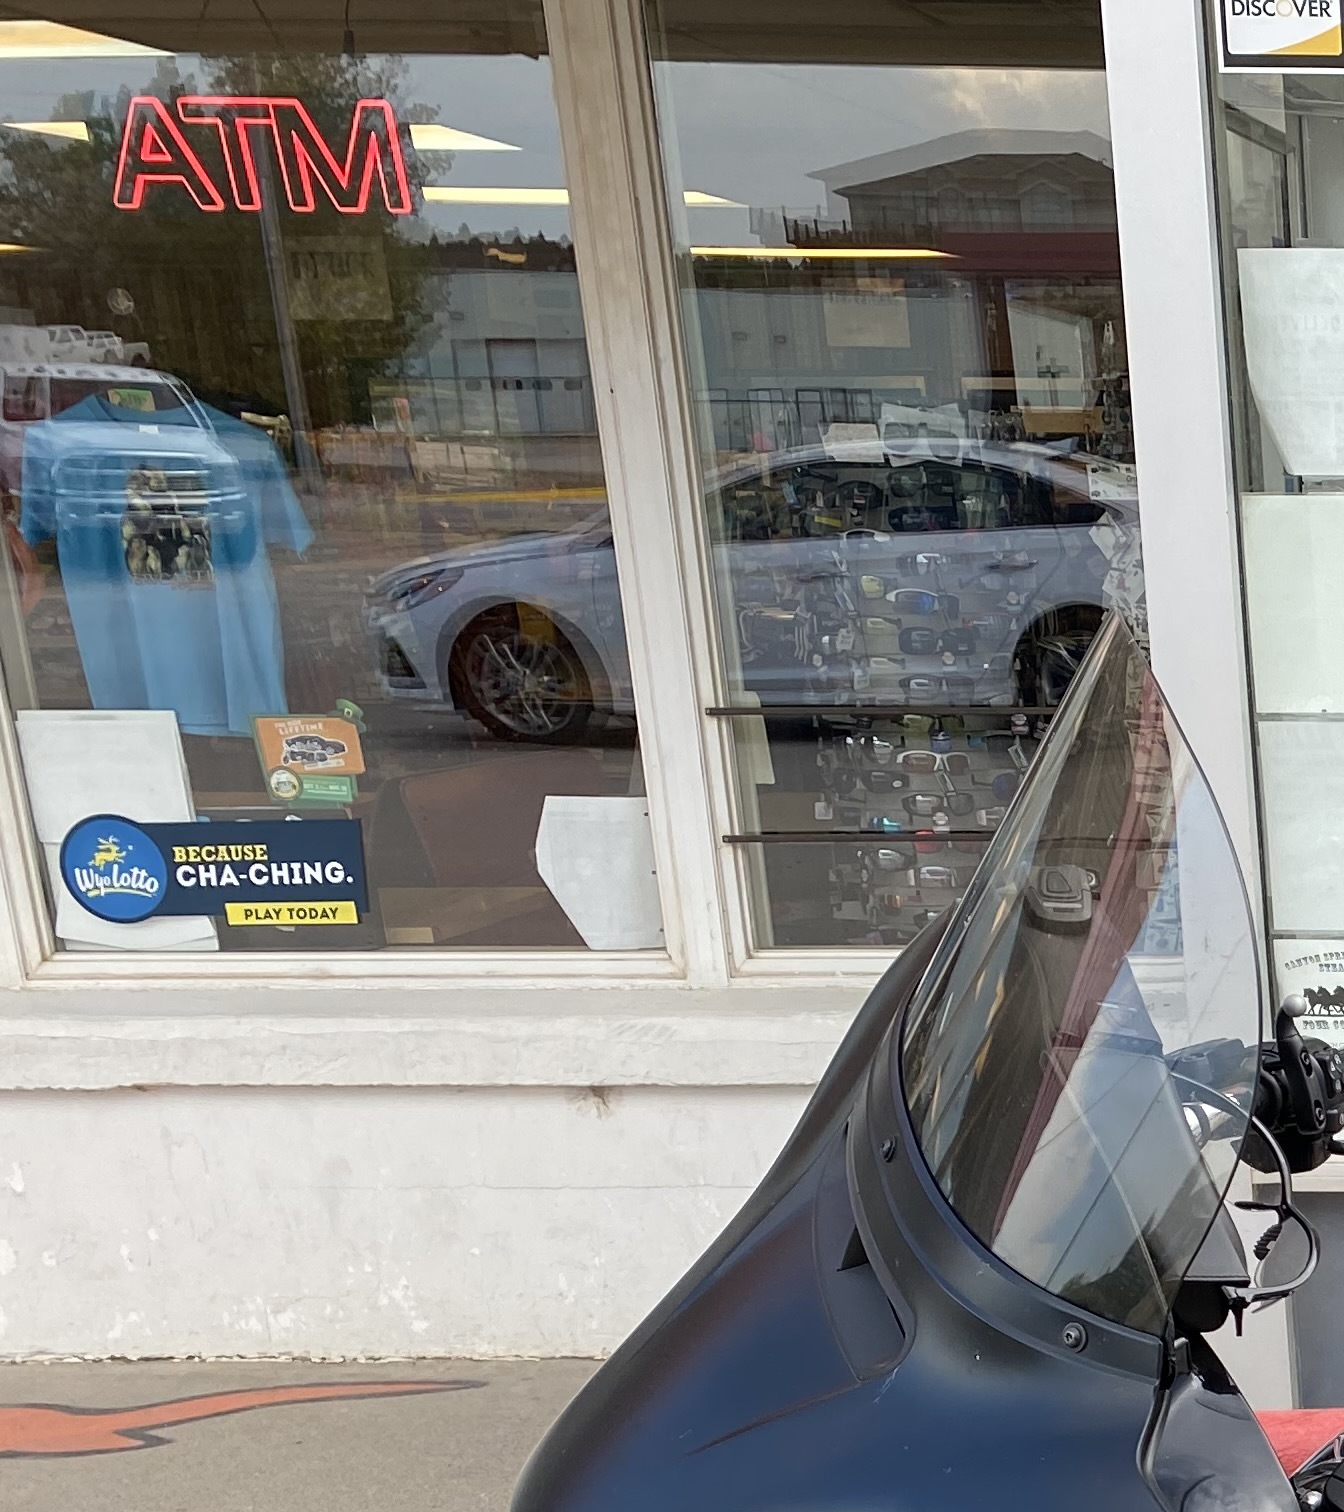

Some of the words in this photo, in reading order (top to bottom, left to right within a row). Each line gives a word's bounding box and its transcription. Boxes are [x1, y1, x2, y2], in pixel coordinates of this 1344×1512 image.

[1231, 0, 1332, 18] DISCOVER
[114, 96, 411, 213] ATM
[172, 844, 269, 863] BECAUSE
[176, 861, 355, 888] CHA-CHING.
[244, 908, 281, 921] PLAY
[287, 907, 339, 920] TODAY
